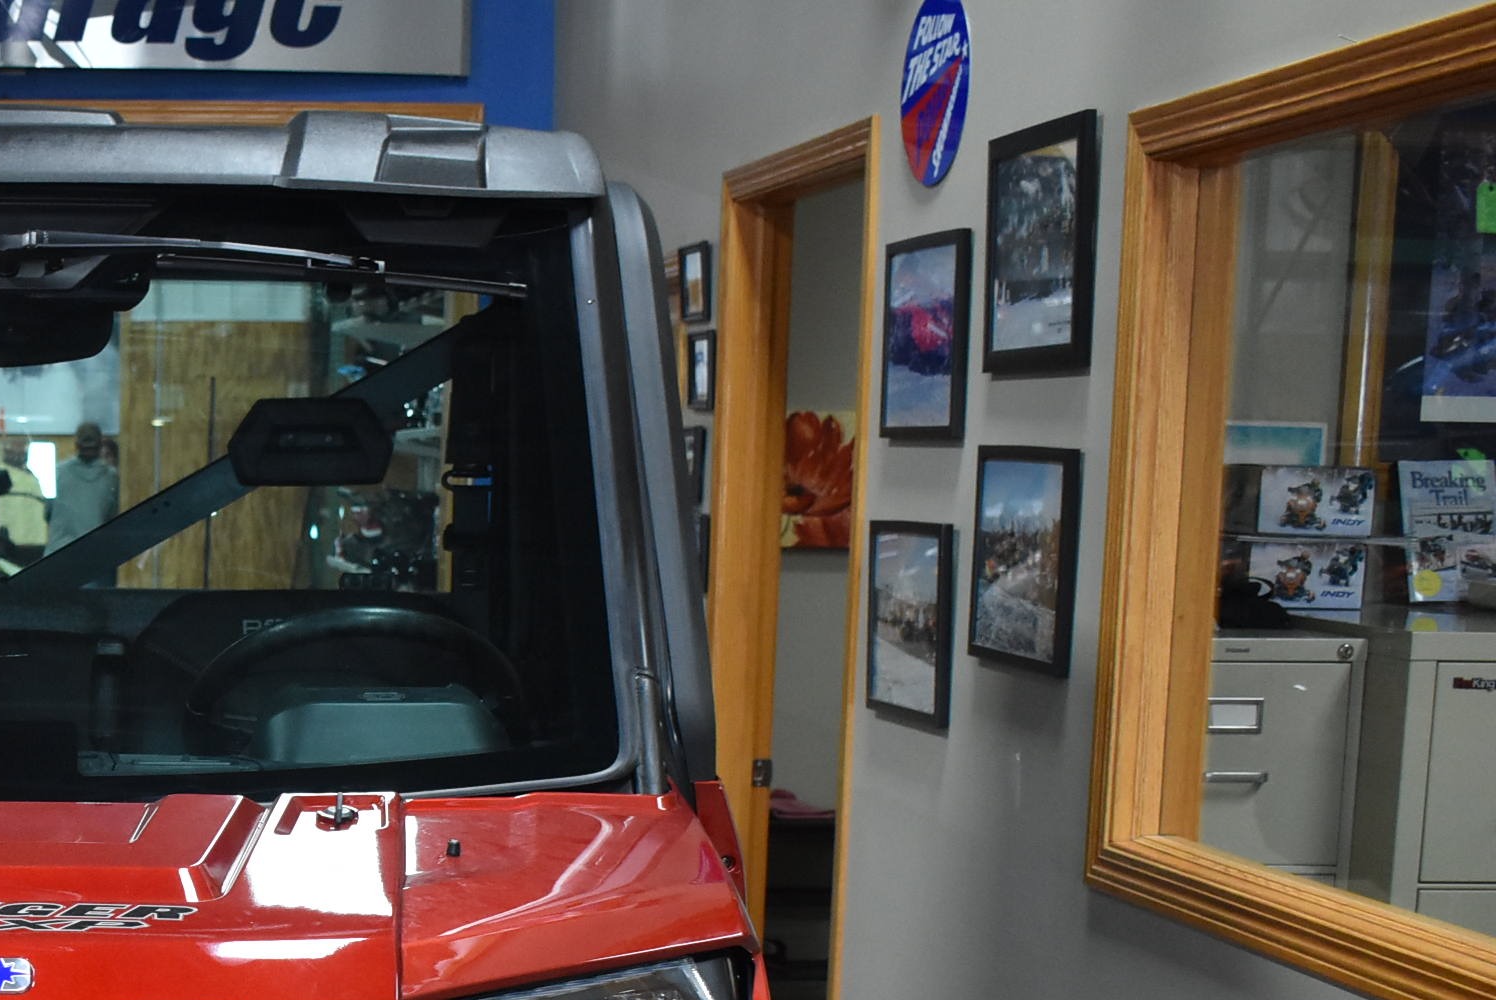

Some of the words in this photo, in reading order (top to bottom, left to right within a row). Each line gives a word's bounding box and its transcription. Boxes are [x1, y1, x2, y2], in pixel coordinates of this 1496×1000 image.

[902, 46, 935, 105] THE
[1410, 472, 1487, 491] Breaking
[1429, 488, 1468, 506] Trail
[1331, 518, 1366, 526] INDY
[1320, 590, 1355, 598] INDY
